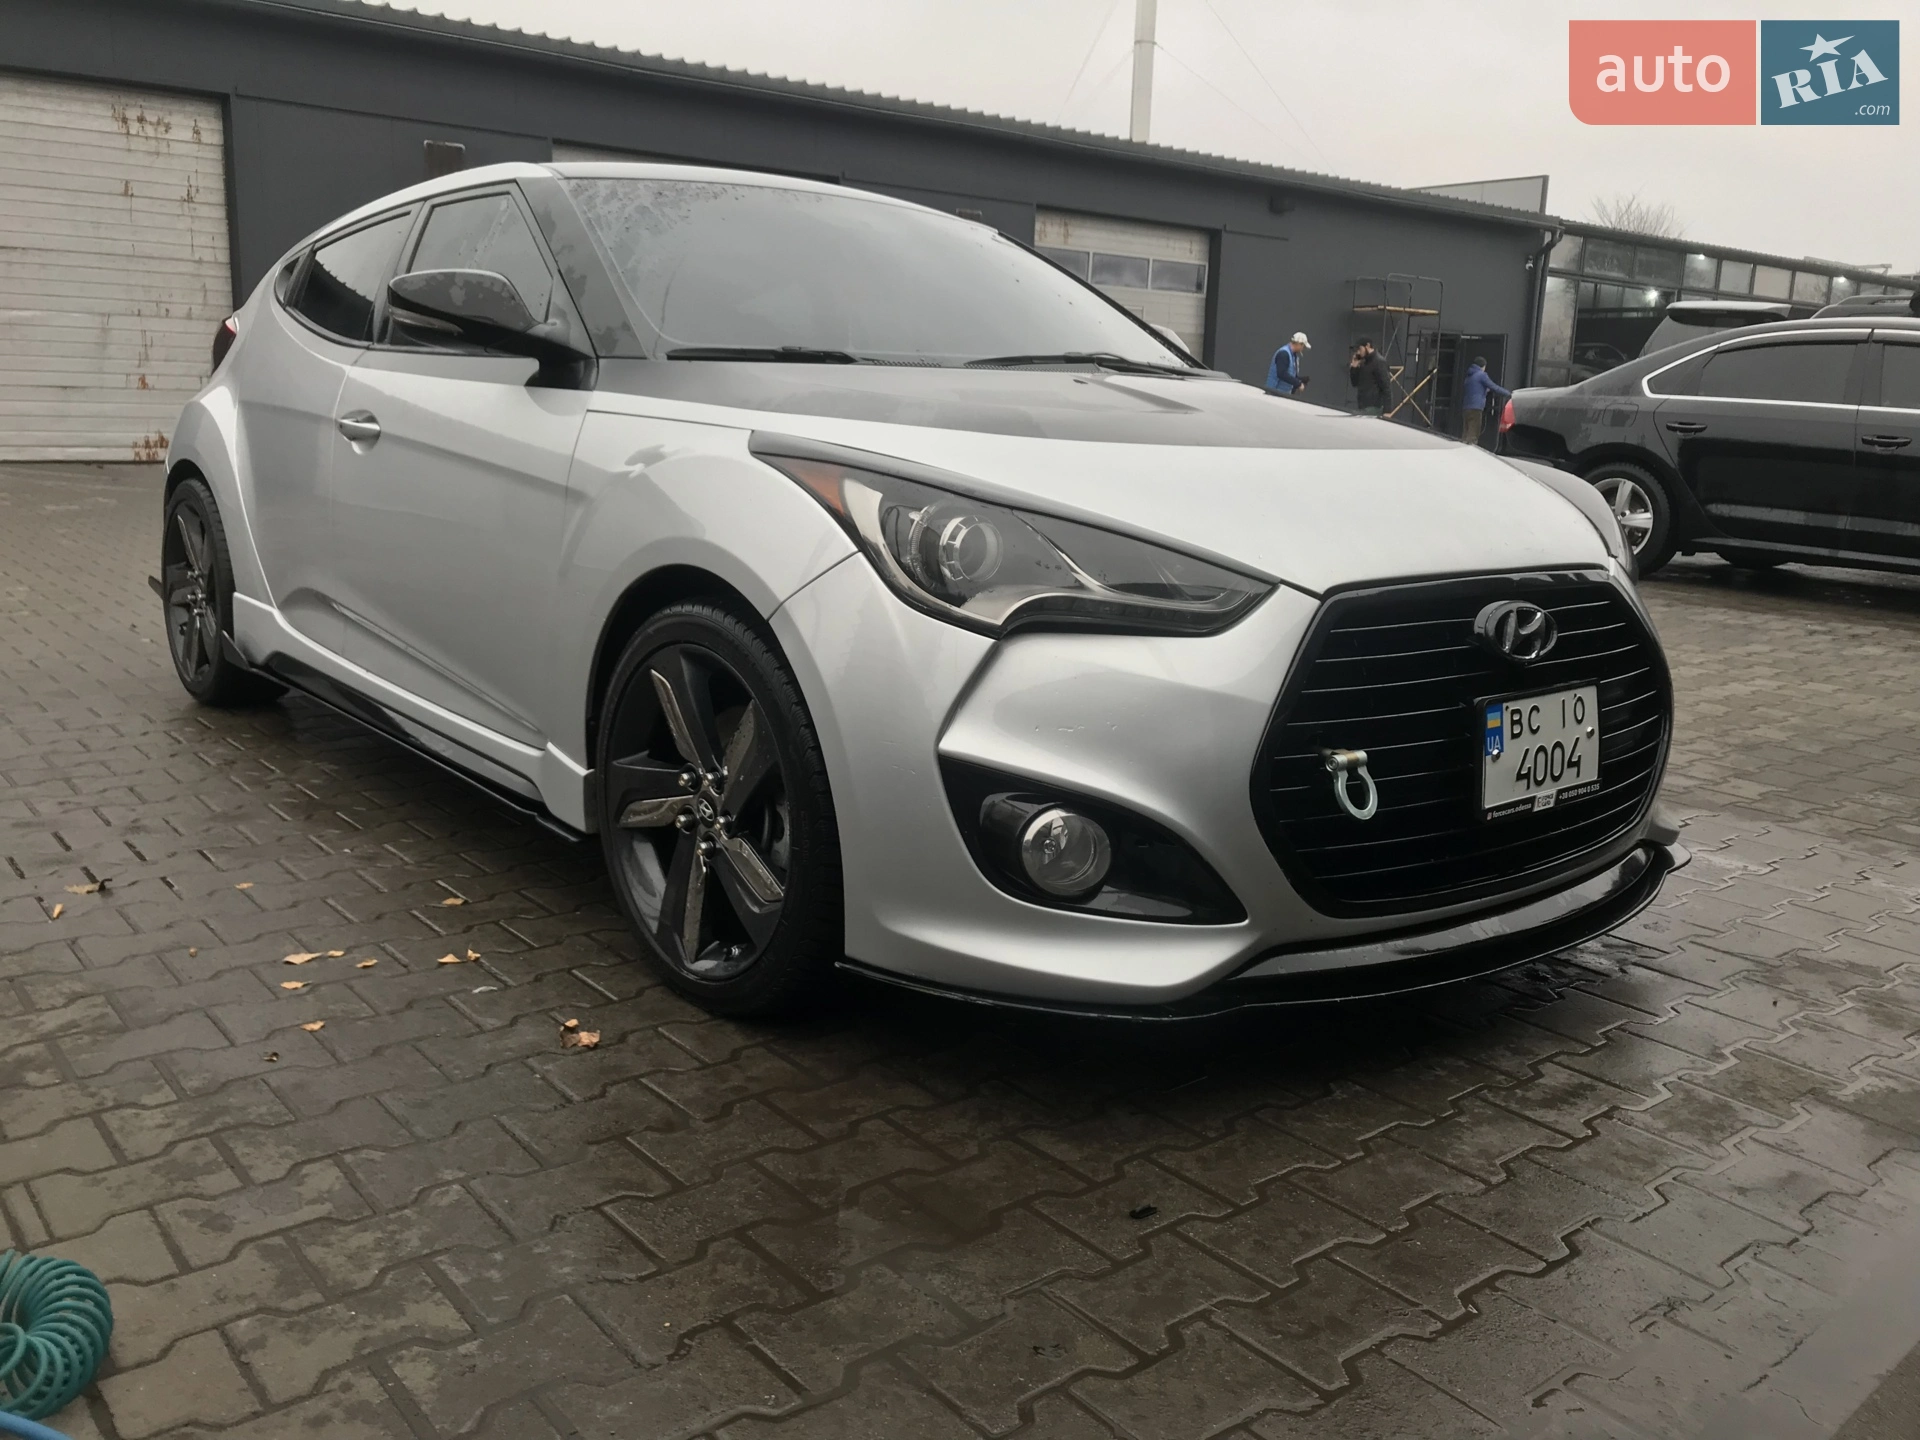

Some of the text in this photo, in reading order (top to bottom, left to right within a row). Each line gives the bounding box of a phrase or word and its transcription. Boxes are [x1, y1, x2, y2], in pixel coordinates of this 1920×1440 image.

[1510, 704, 1541, 740] BC
[1487, 735, 1501, 752] UA
[1515, 736, 1582, 790] 4004
